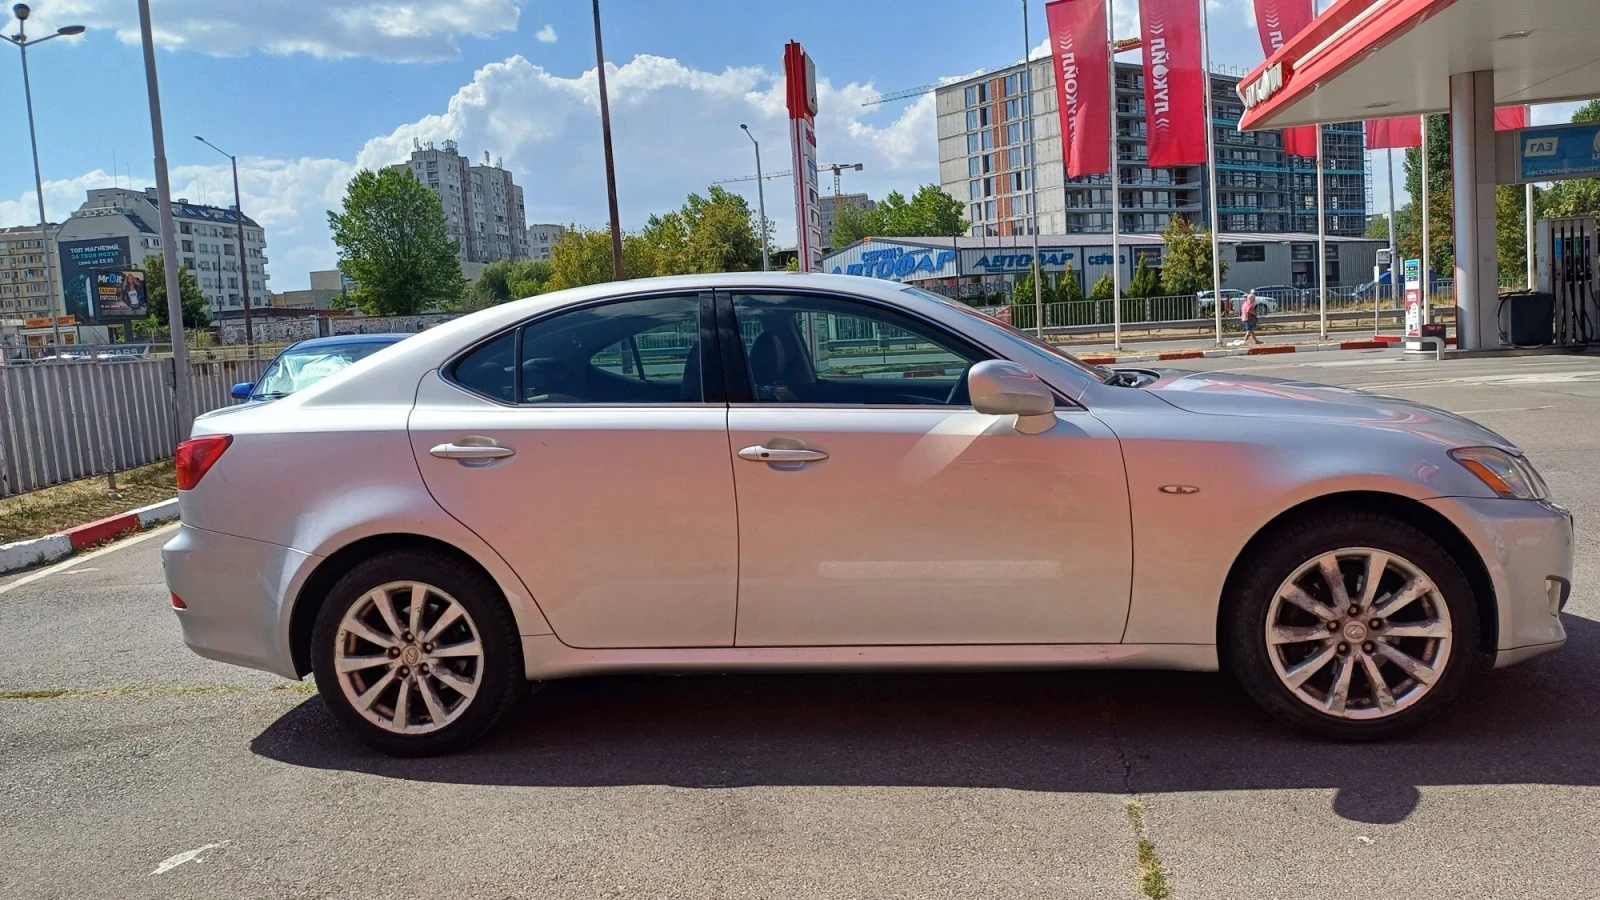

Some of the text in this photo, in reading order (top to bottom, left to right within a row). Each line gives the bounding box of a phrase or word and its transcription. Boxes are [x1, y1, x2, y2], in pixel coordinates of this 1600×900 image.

[1530, 142, 1553, 152] ГАЗ
[84, 243, 119, 252] МАГНЕЗИЙ
[862, 247, 904, 262] СЕРВИЗ
[1088, 254, 1126, 266] СЕРВЗ
[926, 281, 1012, 297] ВТОСЕРВИЗ
